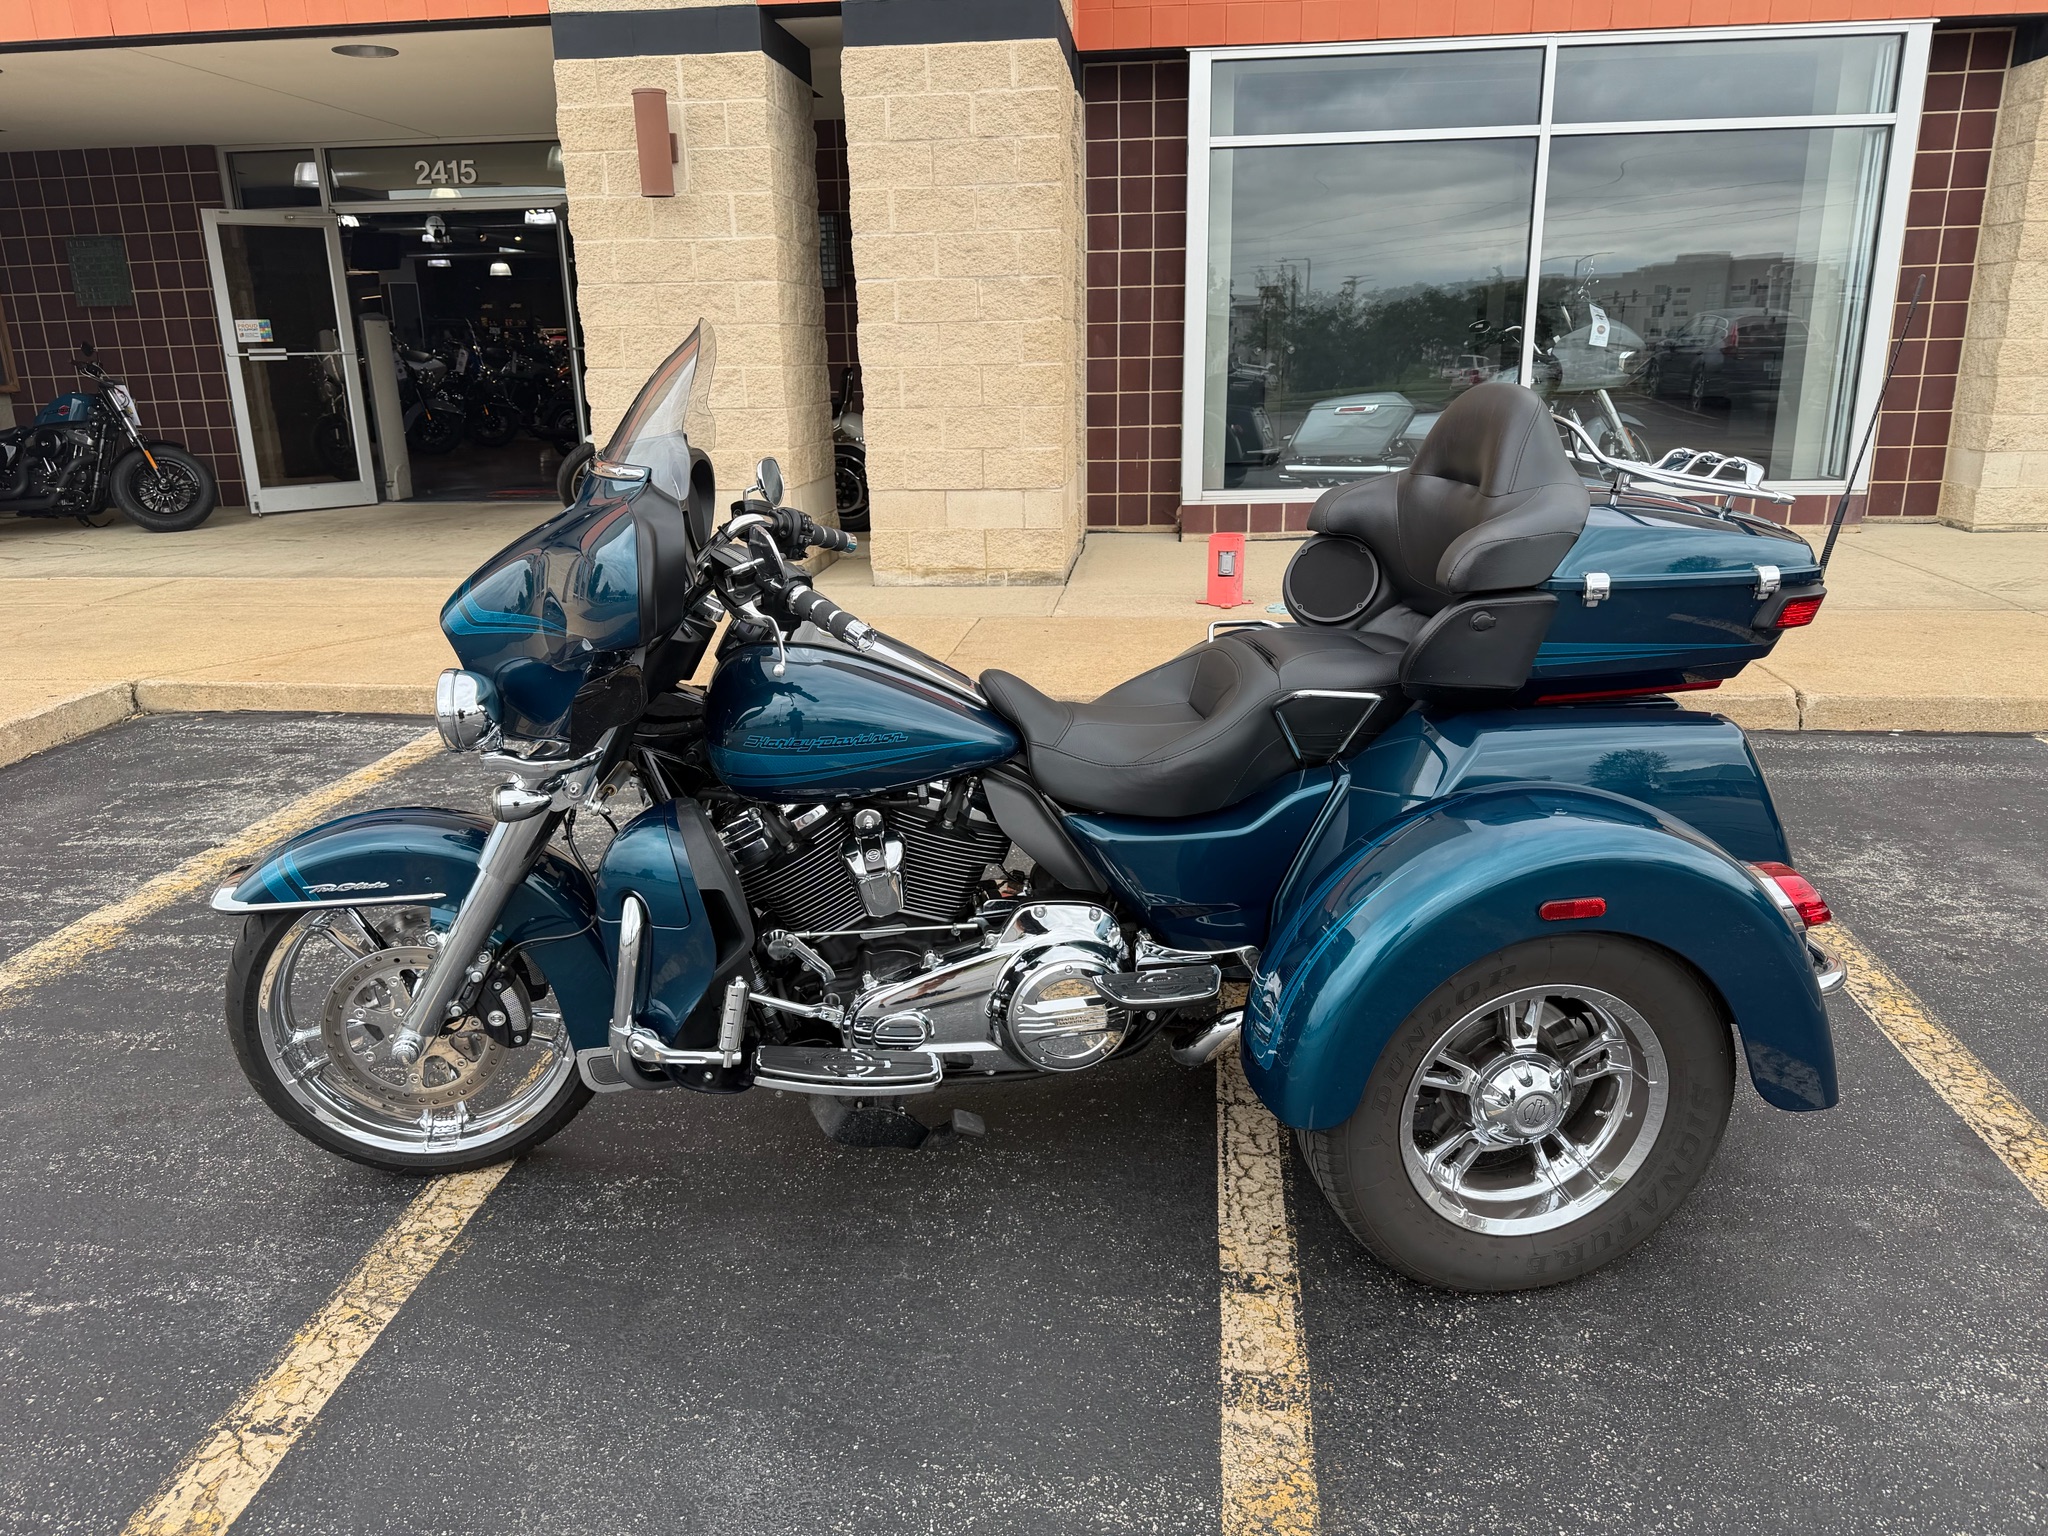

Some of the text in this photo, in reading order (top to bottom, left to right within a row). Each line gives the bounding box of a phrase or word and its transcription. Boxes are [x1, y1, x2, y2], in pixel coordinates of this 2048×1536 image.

[414, 159, 477, 185] 2415
[743, 732, 909, 752] Harley-Davidson
[1372, 964, 1517, 1116] DUNLOP
[1526, 1082, 1714, 1275] SIGNATURE
